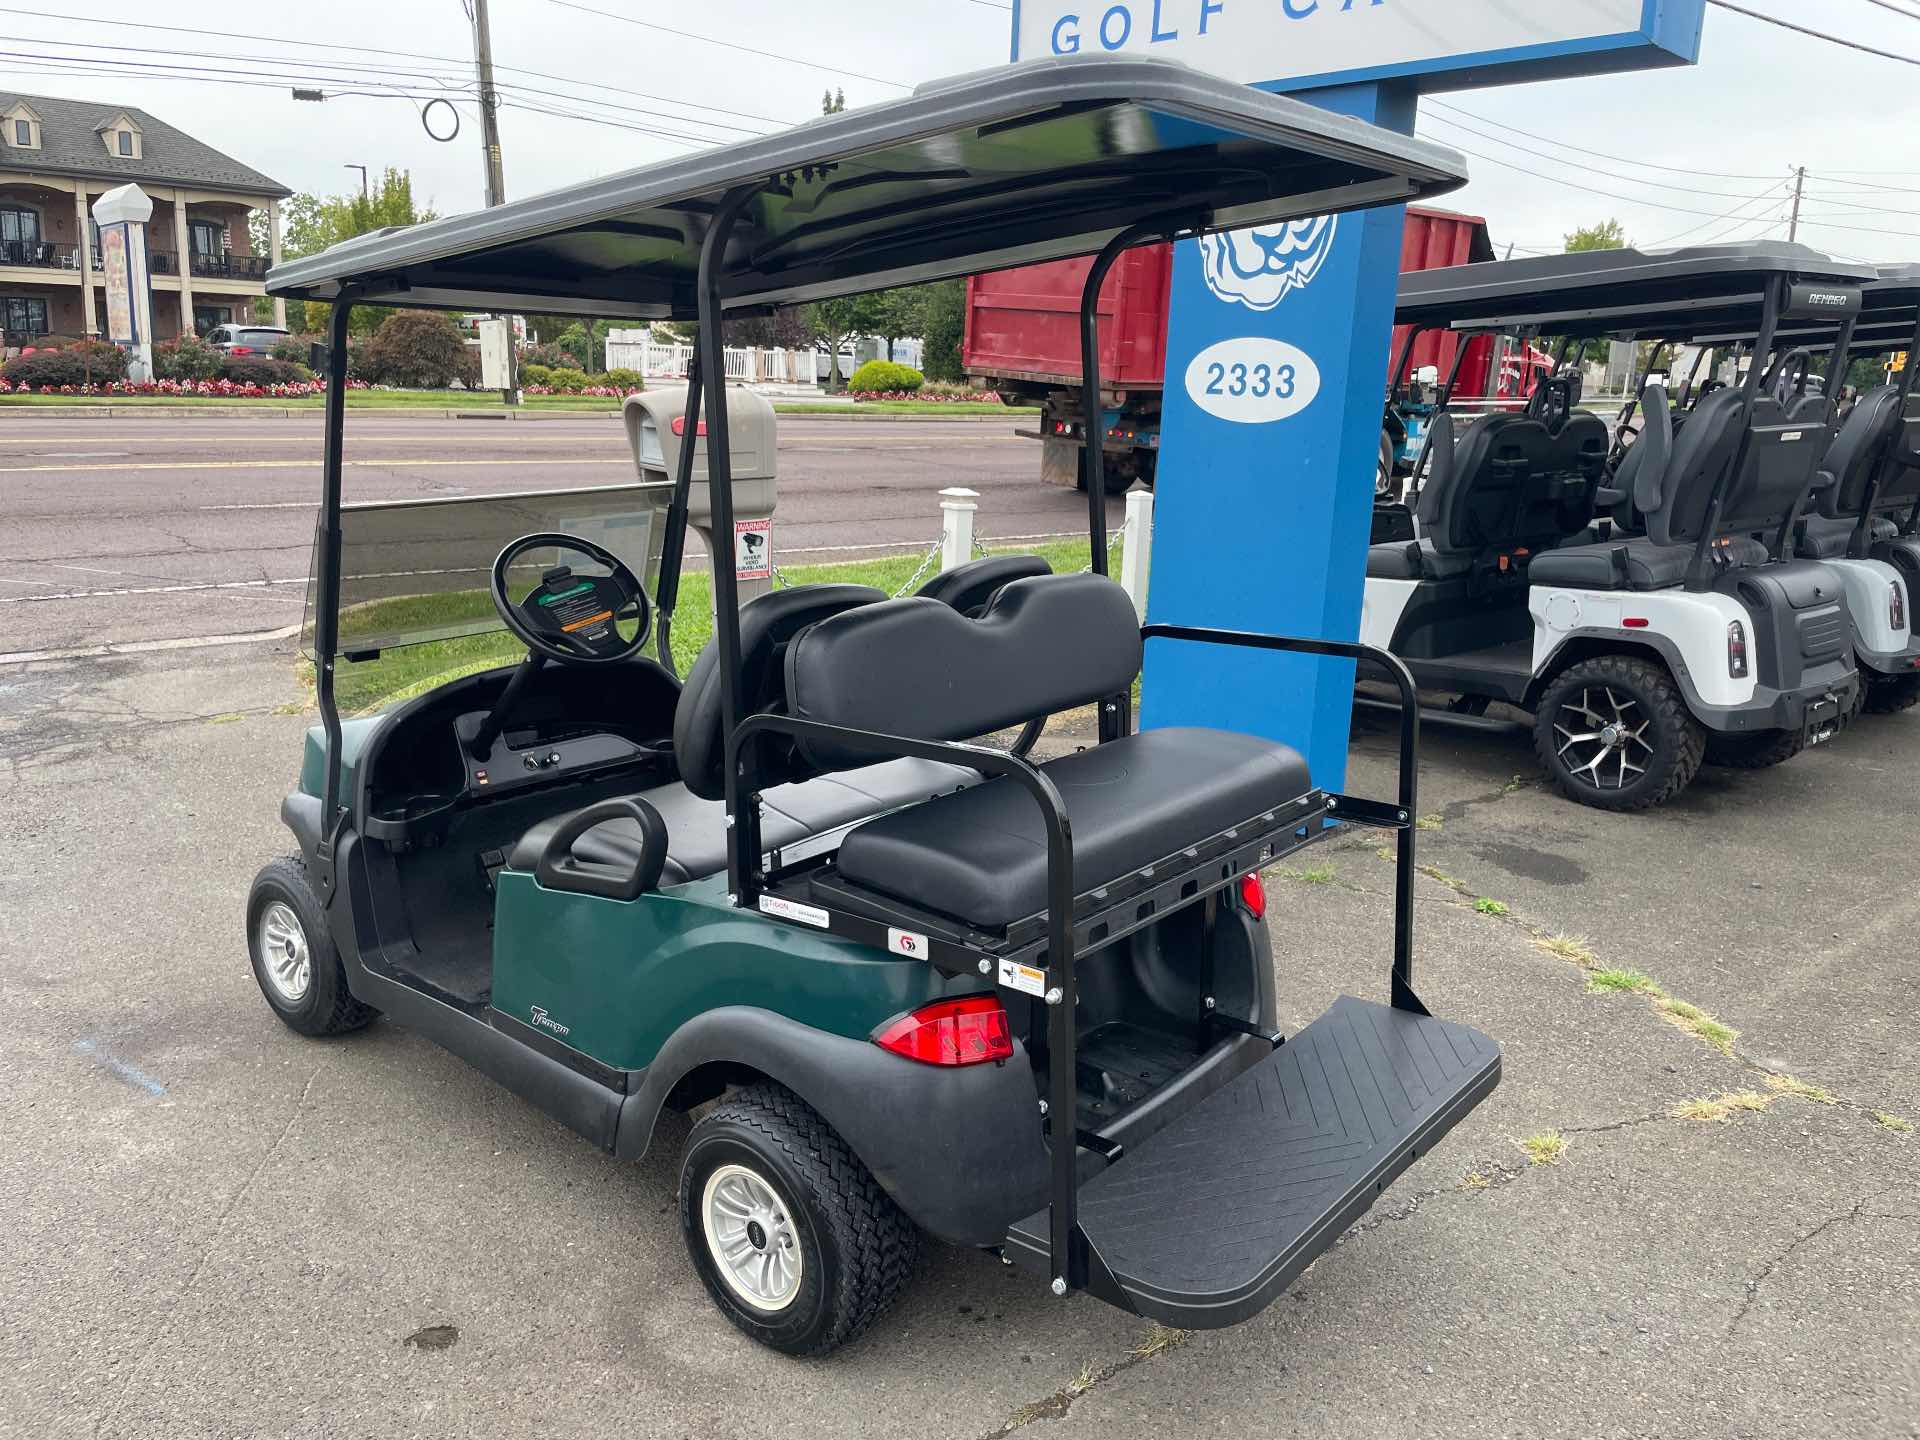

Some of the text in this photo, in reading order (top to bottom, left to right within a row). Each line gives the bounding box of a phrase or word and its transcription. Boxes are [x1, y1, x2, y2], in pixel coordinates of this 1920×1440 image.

[1051, 0, 1223, 55] GOLF
[1205, 362, 1296, 399] 2333
[737, 521, 769, 530] WARNING
